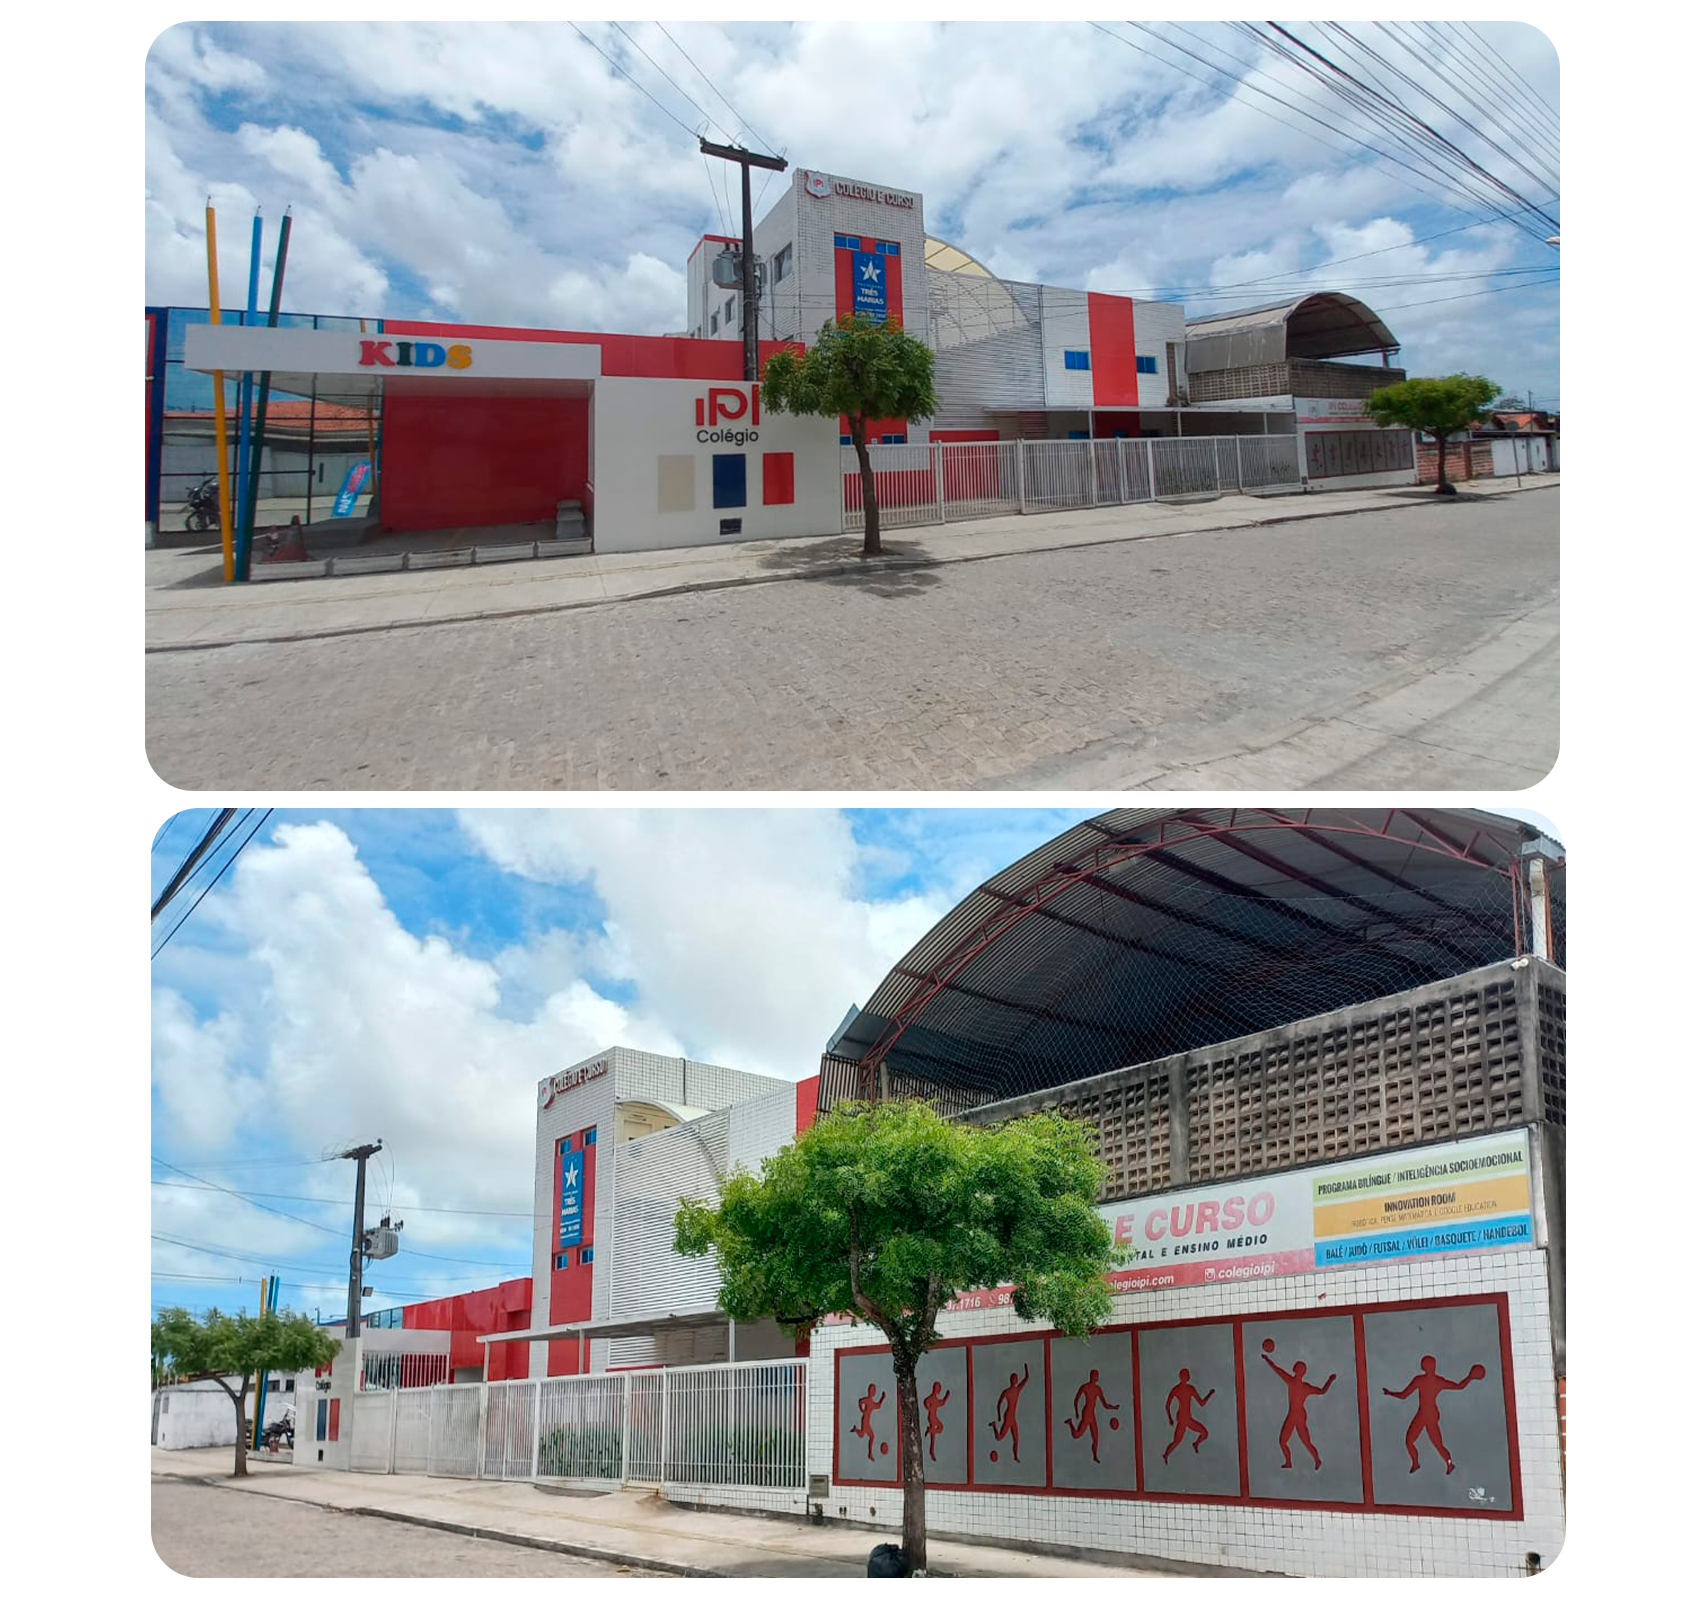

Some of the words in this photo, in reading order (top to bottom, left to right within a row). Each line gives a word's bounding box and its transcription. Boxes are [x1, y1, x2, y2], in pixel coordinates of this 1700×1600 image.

[358, 340, 473, 369] KIDS
[697, 429, 759, 447] Colégio
[1318, 1179, 1358, 1196] PROGRAMA
[1358, 1173, 1392, 1190] BILÍNGUE
[1397, 1164, 1448, 1183] INTELIGÊNCIA
[1449, 1151, 1523, 1174] SOCIOEMOCIONAL
[1385, 1196, 1430, 1213] INNOVATION
[1431, 1192, 1457, 1207] ROOM
[1114, 1213, 1135, 1245] E
[1144, 1191, 1276, 1241] CURSO
[1161, 1247, 1169, 1258] E
[1174, 1241, 1220, 1256] ENSINO
[1227, 1233, 1268, 1250] MÉDIO
[1373, 1240, 1401, 1254] FUTSAL
[1435, 1230, 1476, 1247] BASQUETE
[1483, 1224, 1529, 1241] HANDEBOL
[1217, 1260, 1276, 1281] colegioipi
